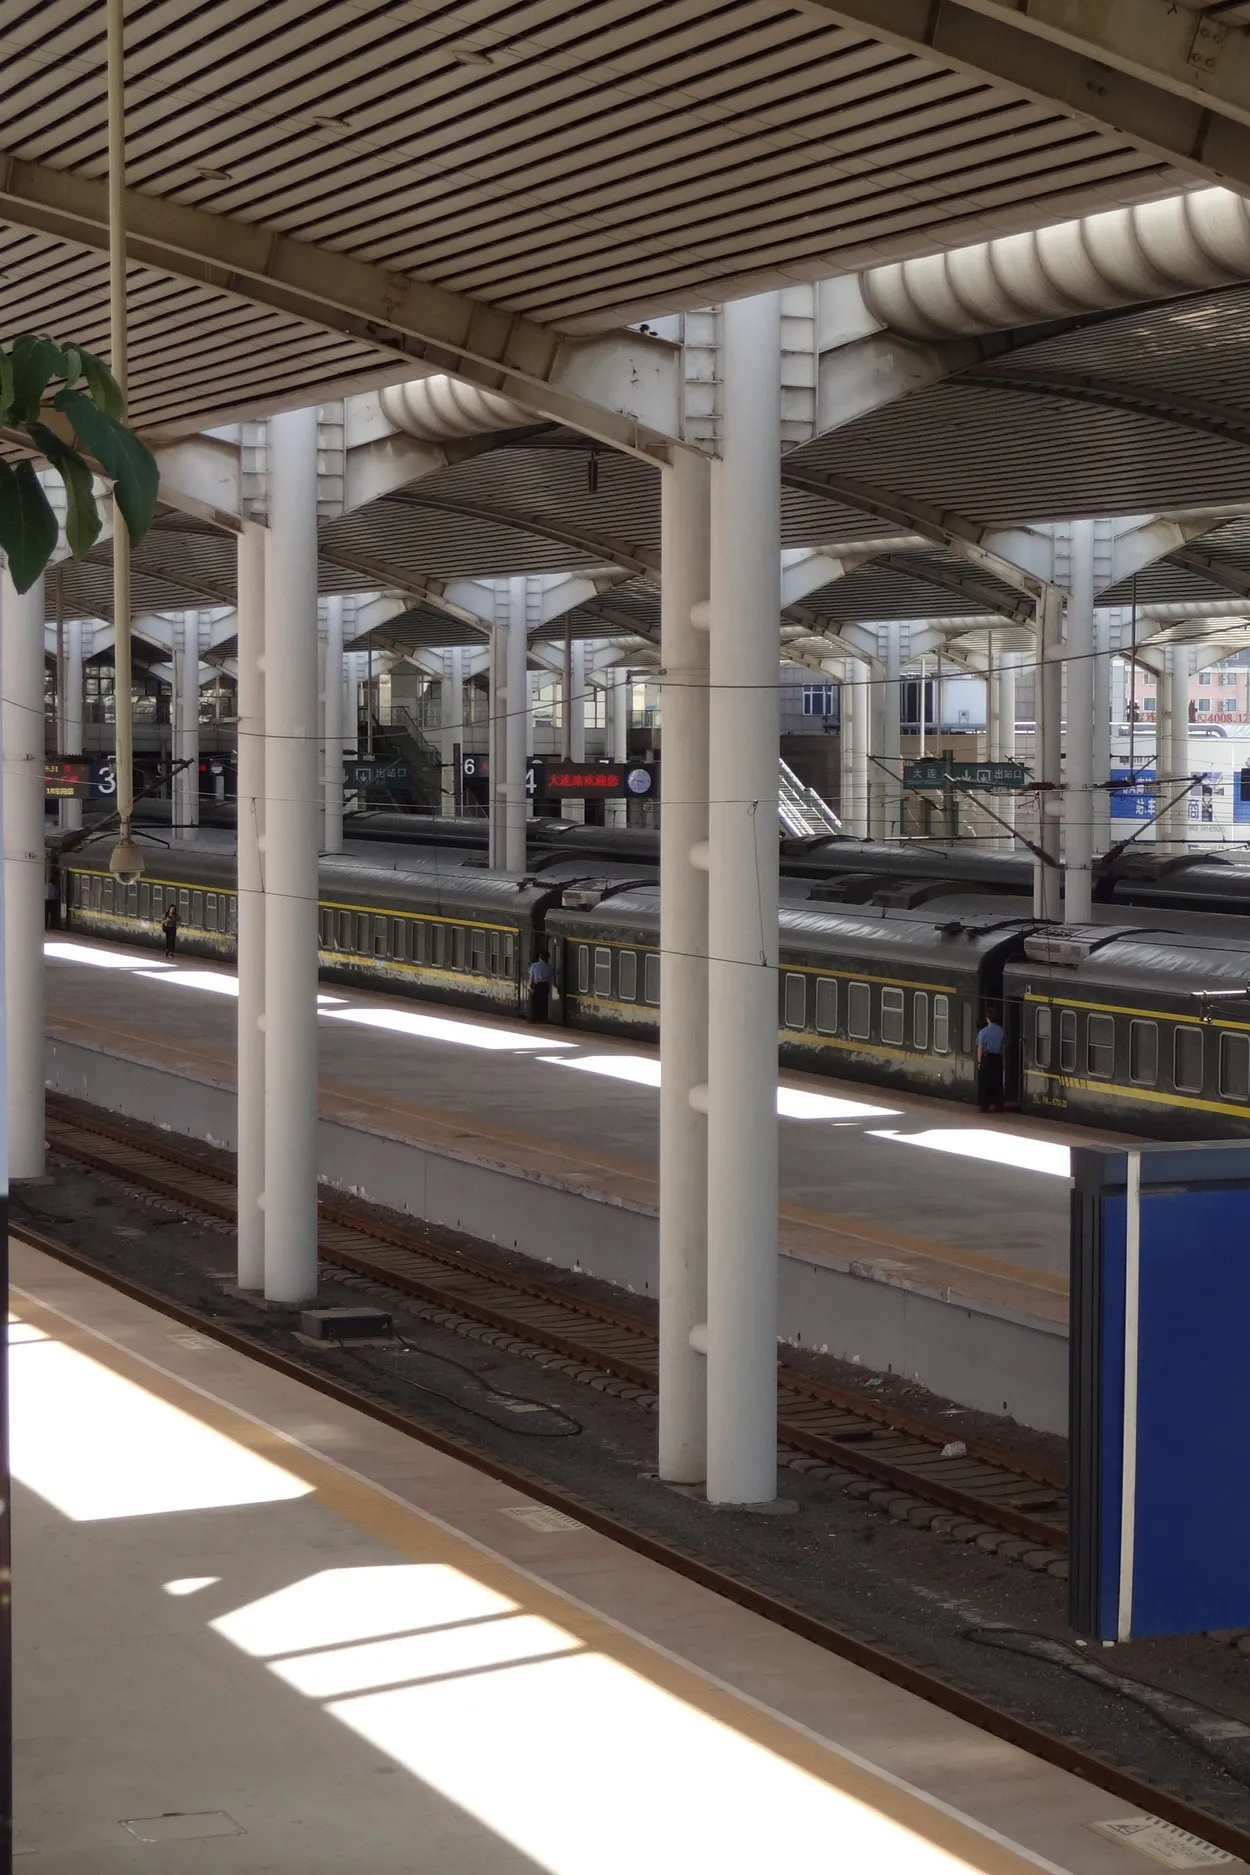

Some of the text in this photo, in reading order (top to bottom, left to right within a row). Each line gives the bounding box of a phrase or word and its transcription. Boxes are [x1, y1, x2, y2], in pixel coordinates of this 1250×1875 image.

[464, 758, 475, 775] 6
[994, 769, 1022, 779] 出站口
[98, 767, 116, 794] 3
